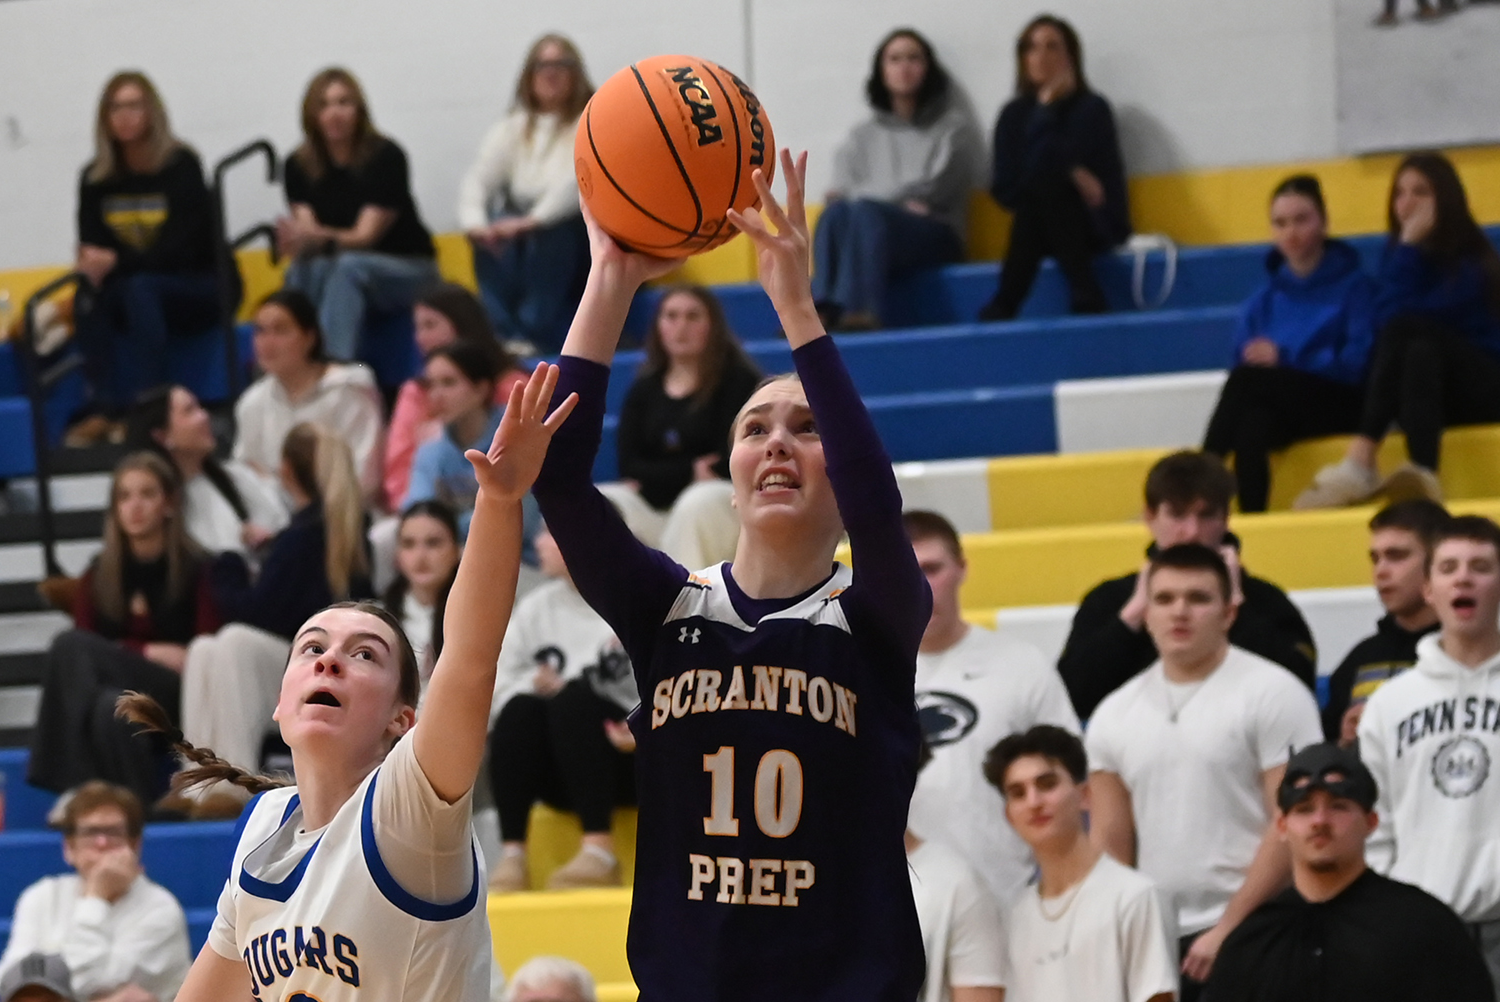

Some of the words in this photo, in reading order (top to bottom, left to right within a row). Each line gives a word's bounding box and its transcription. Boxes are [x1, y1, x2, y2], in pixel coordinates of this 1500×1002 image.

[663, 66, 724, 147] NCAA
[651, 665, 858, 737] SCRANTON
[1396, 698, 1457, 758] PENN
[702, 745, 804, 839] 10
[687, 853, 816, 907] PREP
